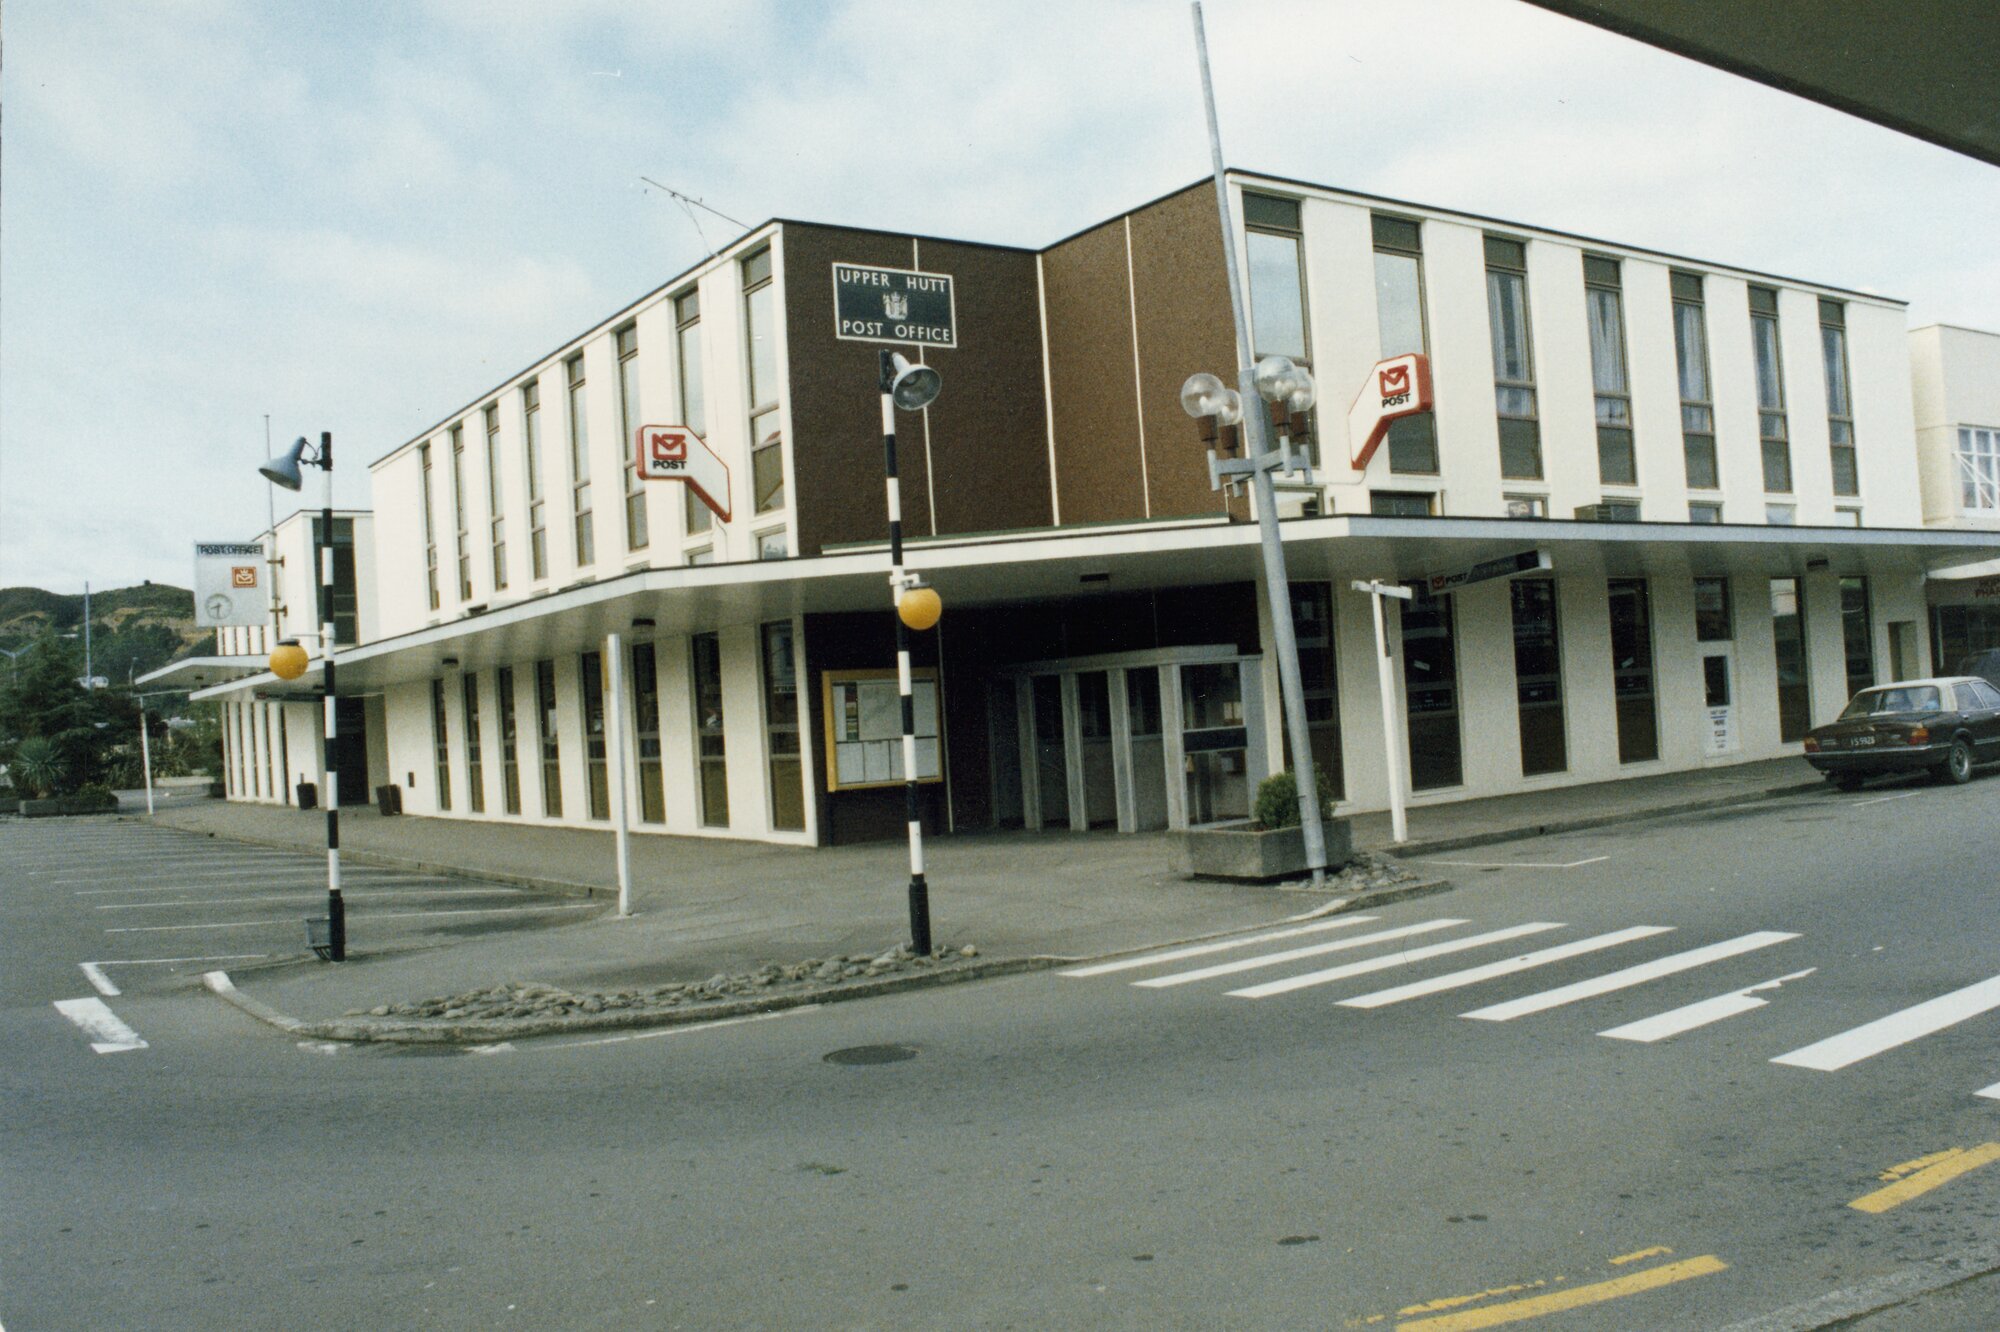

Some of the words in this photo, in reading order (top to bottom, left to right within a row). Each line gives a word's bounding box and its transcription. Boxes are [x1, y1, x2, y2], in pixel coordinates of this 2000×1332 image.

[839, 268, 890, 287] UPPER
[906, 276, 946, 293] HUTT
[842, 319, 884, 336] POST
[895, 324, 950, 342] OFFICE
[1381, 393, 1411, 408] POST
[652, 459, 687, 470] POST
[200, 544, 225, 555] POST
[226, 544, 260, 555] OFFICE
[1445, 572, 1468, 584] POST
